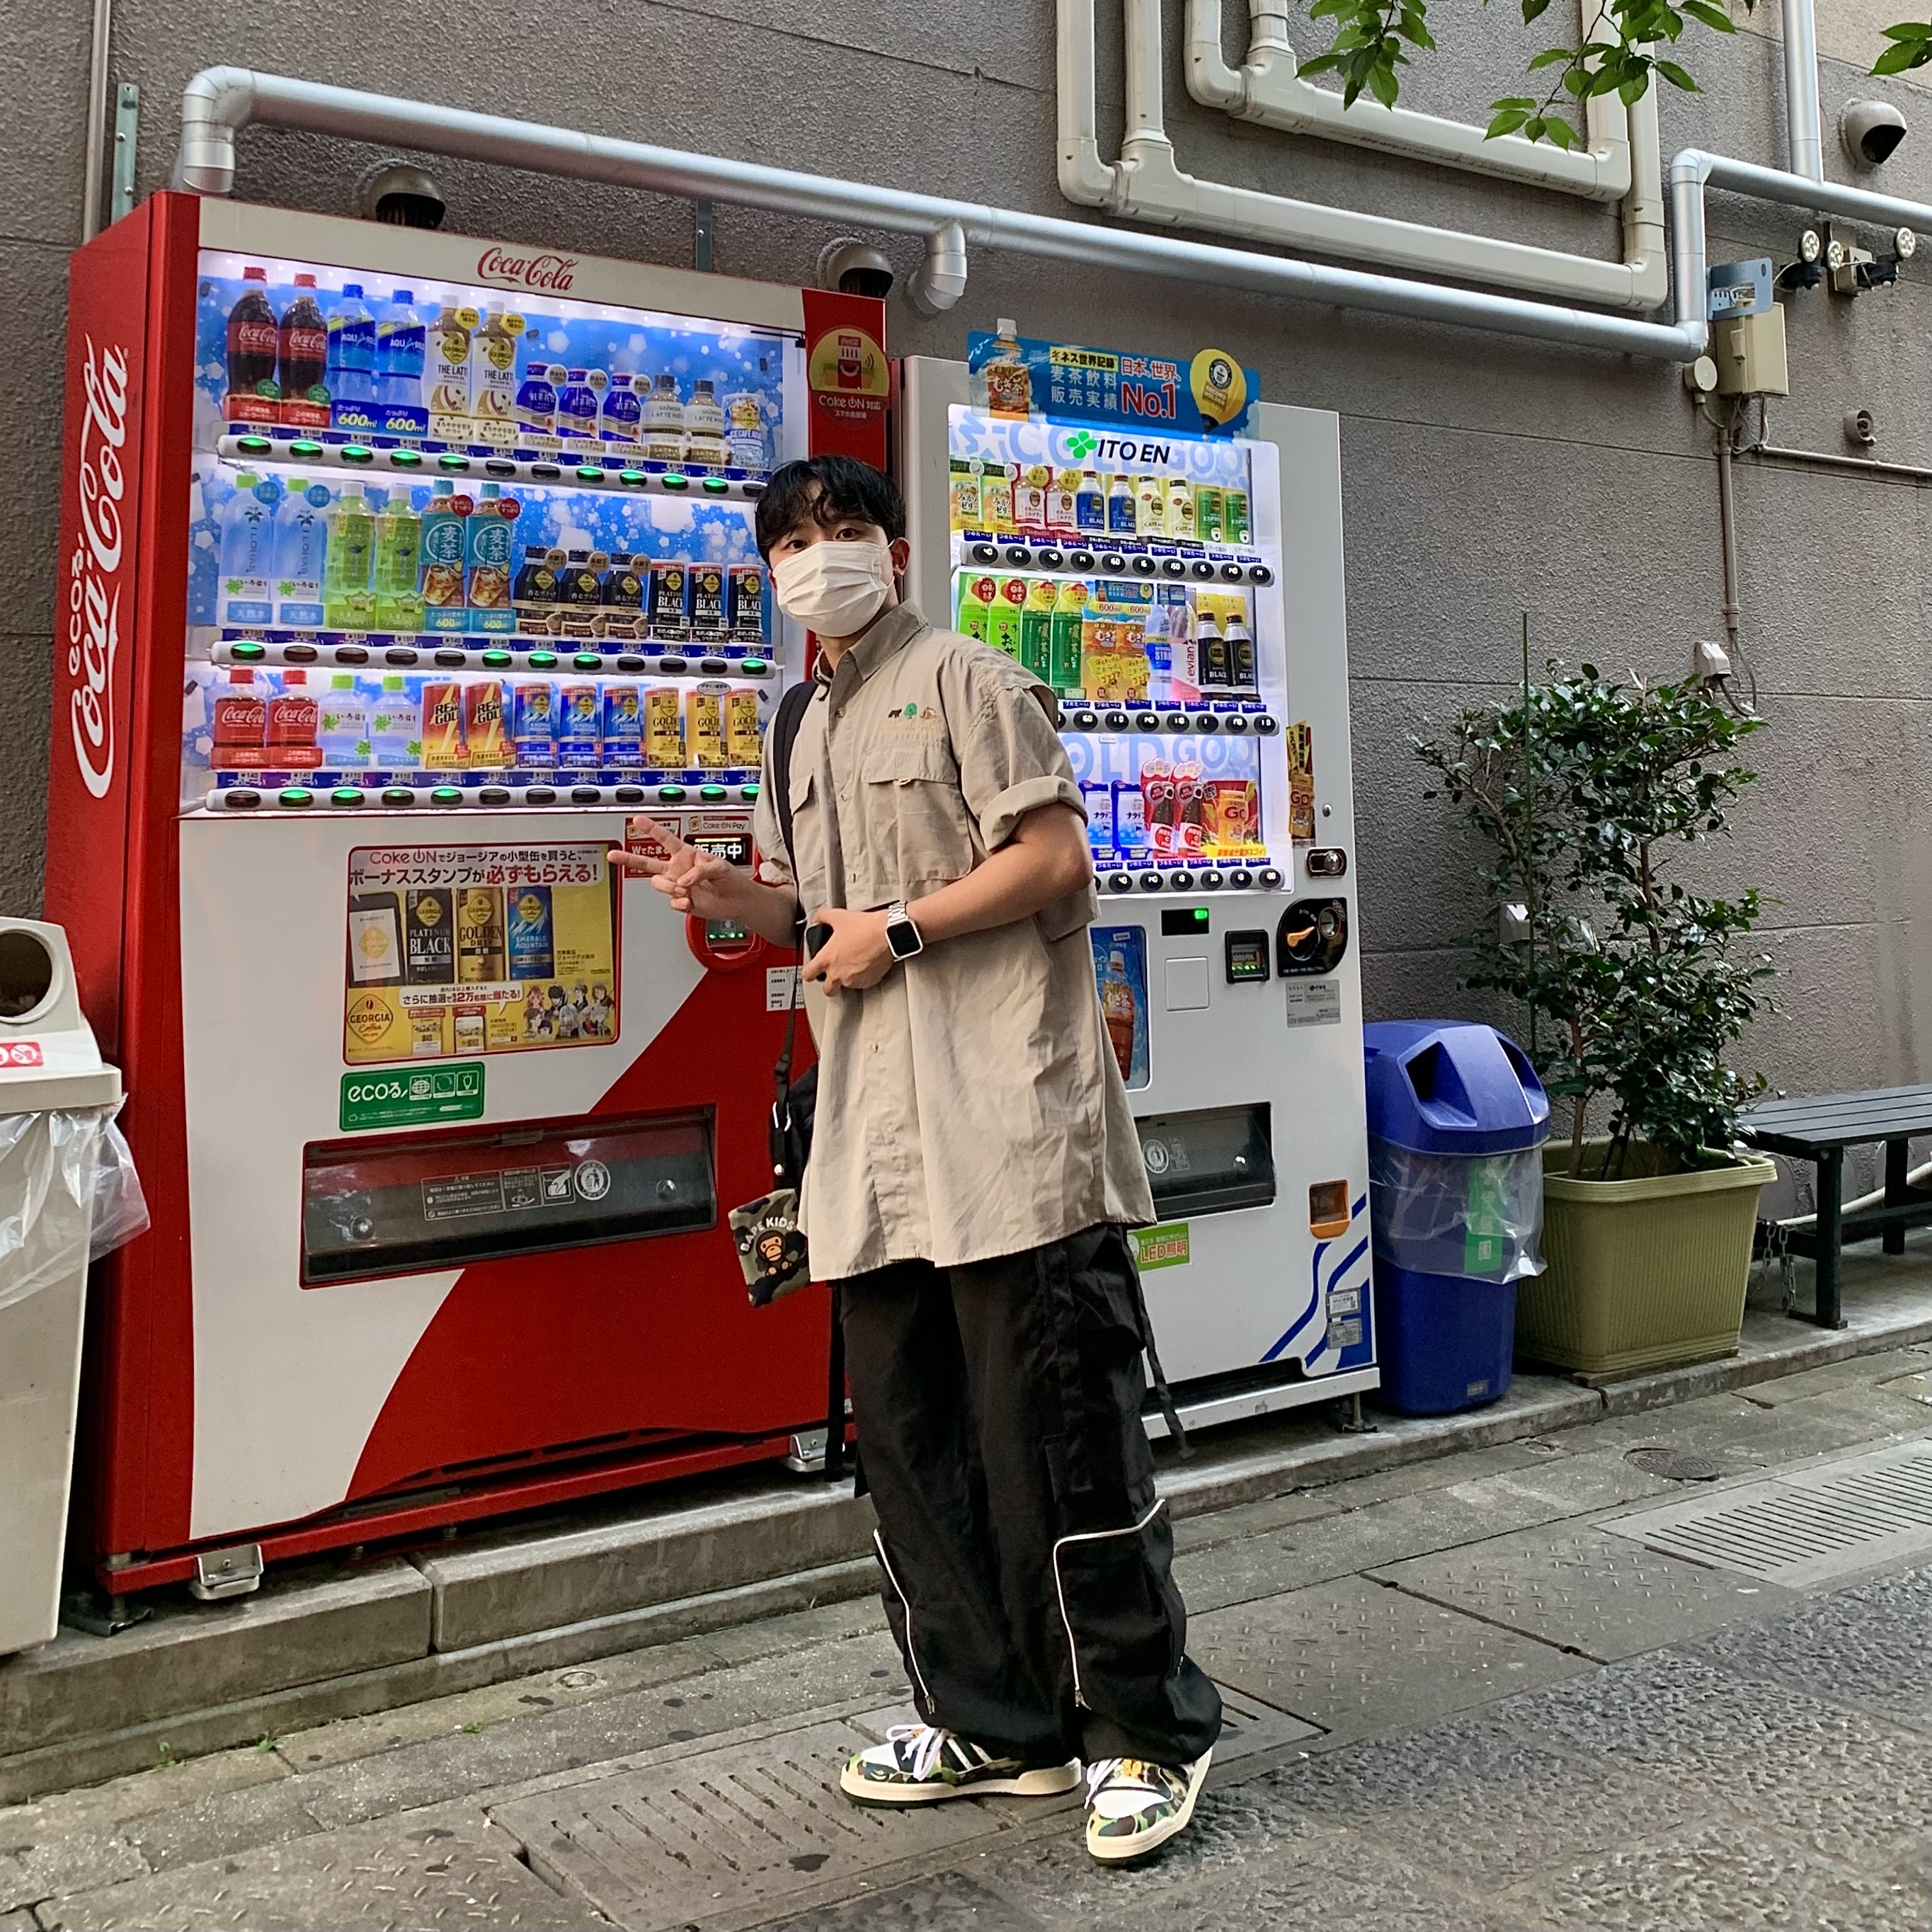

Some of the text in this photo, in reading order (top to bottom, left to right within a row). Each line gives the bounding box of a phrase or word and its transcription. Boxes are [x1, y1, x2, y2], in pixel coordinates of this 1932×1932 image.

[477, 248, 579, 291] Coca-Cola
[438, 365, 451, 374] THE
[484, 370, 497, 379] THE
[1051, 365, 1117, 390] 麦茶飲料
[818, 395, 847, 408] Coke
[1051, 386, 1118, 411] 販売実績
[1121, 382, 1177, 419] No.1
[1097, 438, 1170, 464] ITO EN
[440, 525, 458, 559] 麦茶
[488, 528, 505, 560] 麦茶
[72, 333, 129, 798] Coca-Cola
[1094, 629, 1116, 641] むぎ
[1126, 630, 1145, 643] むぎ
[1187, 645, 1195, 677] evian
[653, 717, 680, 727] GOLDE
[698, 717, 720, 728] GOLD
[733, 716, 759, 726] GOLDE
[732, 822, 745, 830] Pay
[370, 851, 410, 864] Coke
[410, 928, 451, 938] PLATINUM
[460, 925, 503, 942] GOLDEN
[410, 937, 452, 955] BLACK
[349, 1013, 392, 1024] GEORGIA
[741, 1217, 795, 1252] BAPE KIDS
[1141, 1239, 1188, 1264] LED照明
